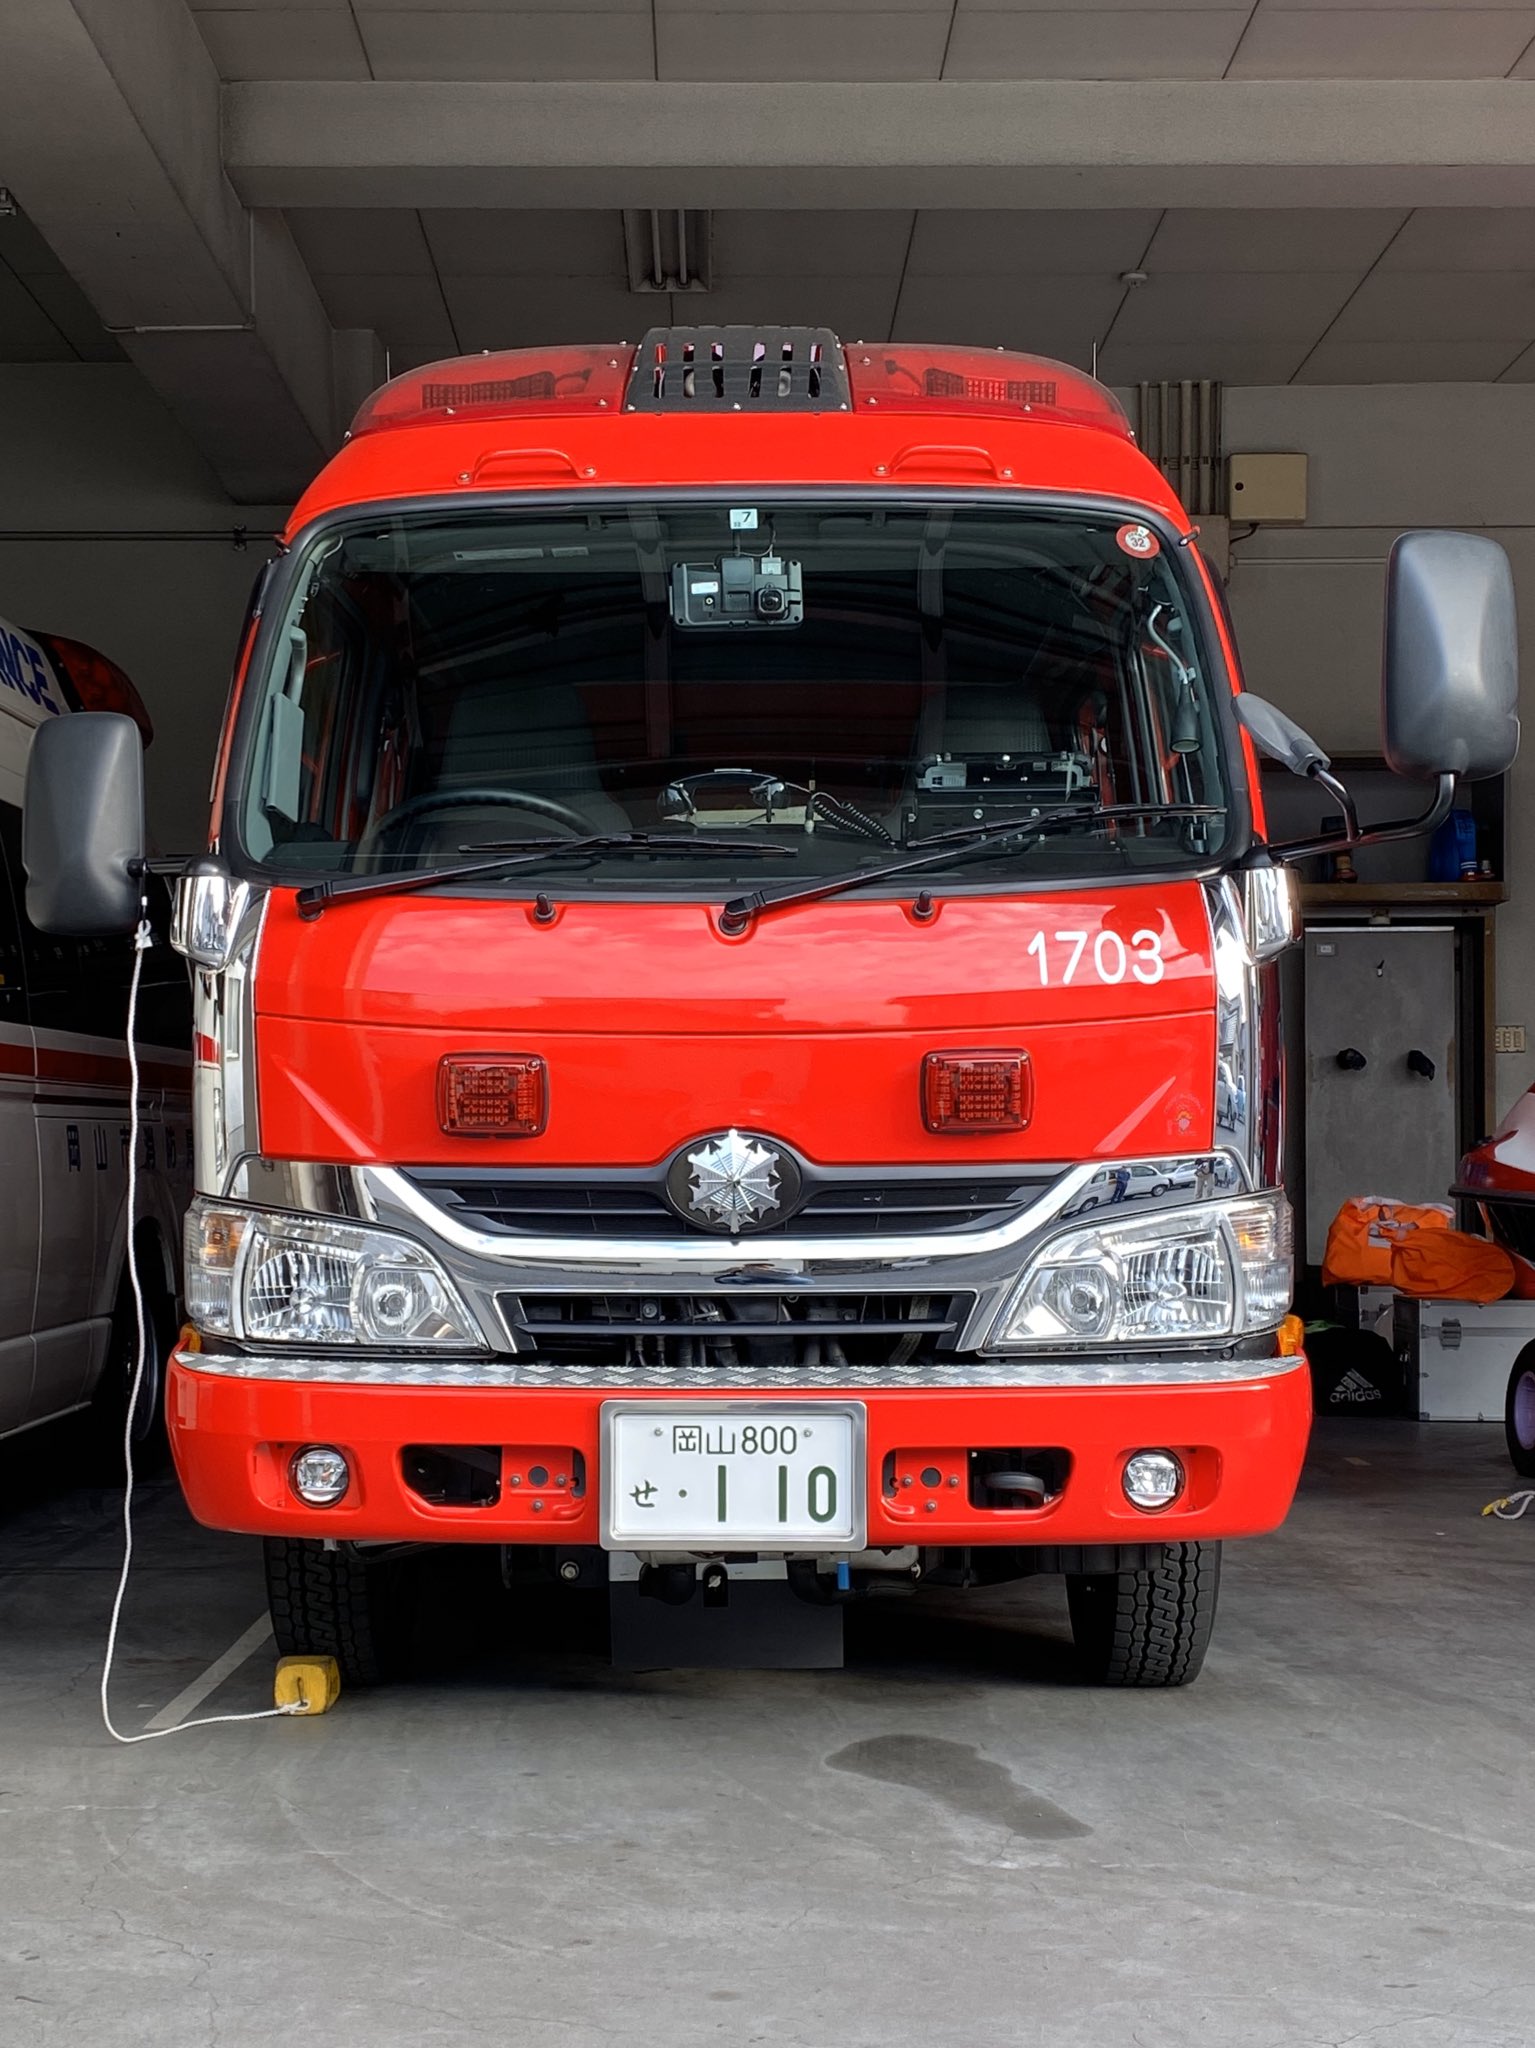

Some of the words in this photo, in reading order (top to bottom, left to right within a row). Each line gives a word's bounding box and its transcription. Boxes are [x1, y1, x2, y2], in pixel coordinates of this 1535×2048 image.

[741, 511, 751, 523] 7
[0, 626, 60, 716] NCE
[1027, 930, 1165, 986] 1703
[1329, 1388, 1382, 1403] adidas
